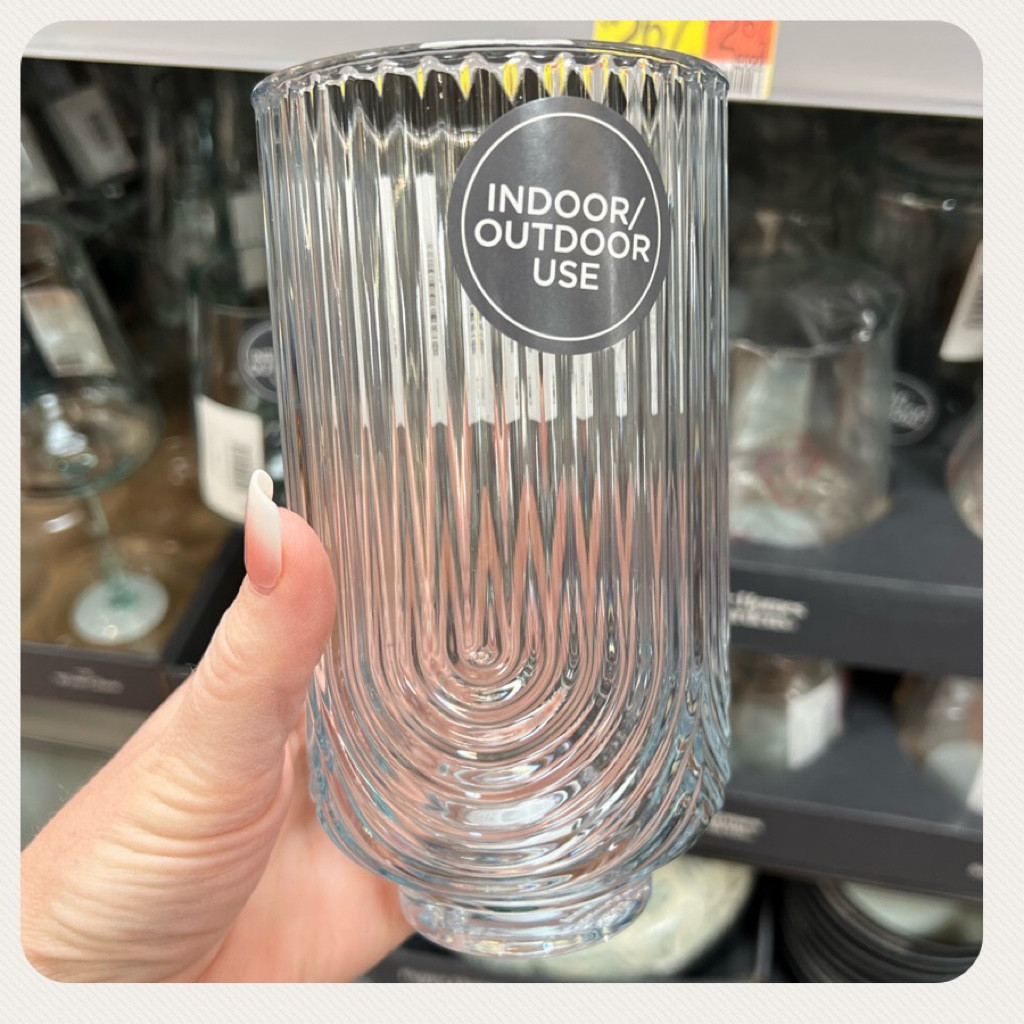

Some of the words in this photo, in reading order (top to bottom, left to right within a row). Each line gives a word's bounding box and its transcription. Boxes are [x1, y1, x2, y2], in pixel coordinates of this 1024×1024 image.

[488, 183, 646, 231] INDOOR/
[474, 218, 651, 263] OUTDOOR
[533, 257, 600, 290] USE
